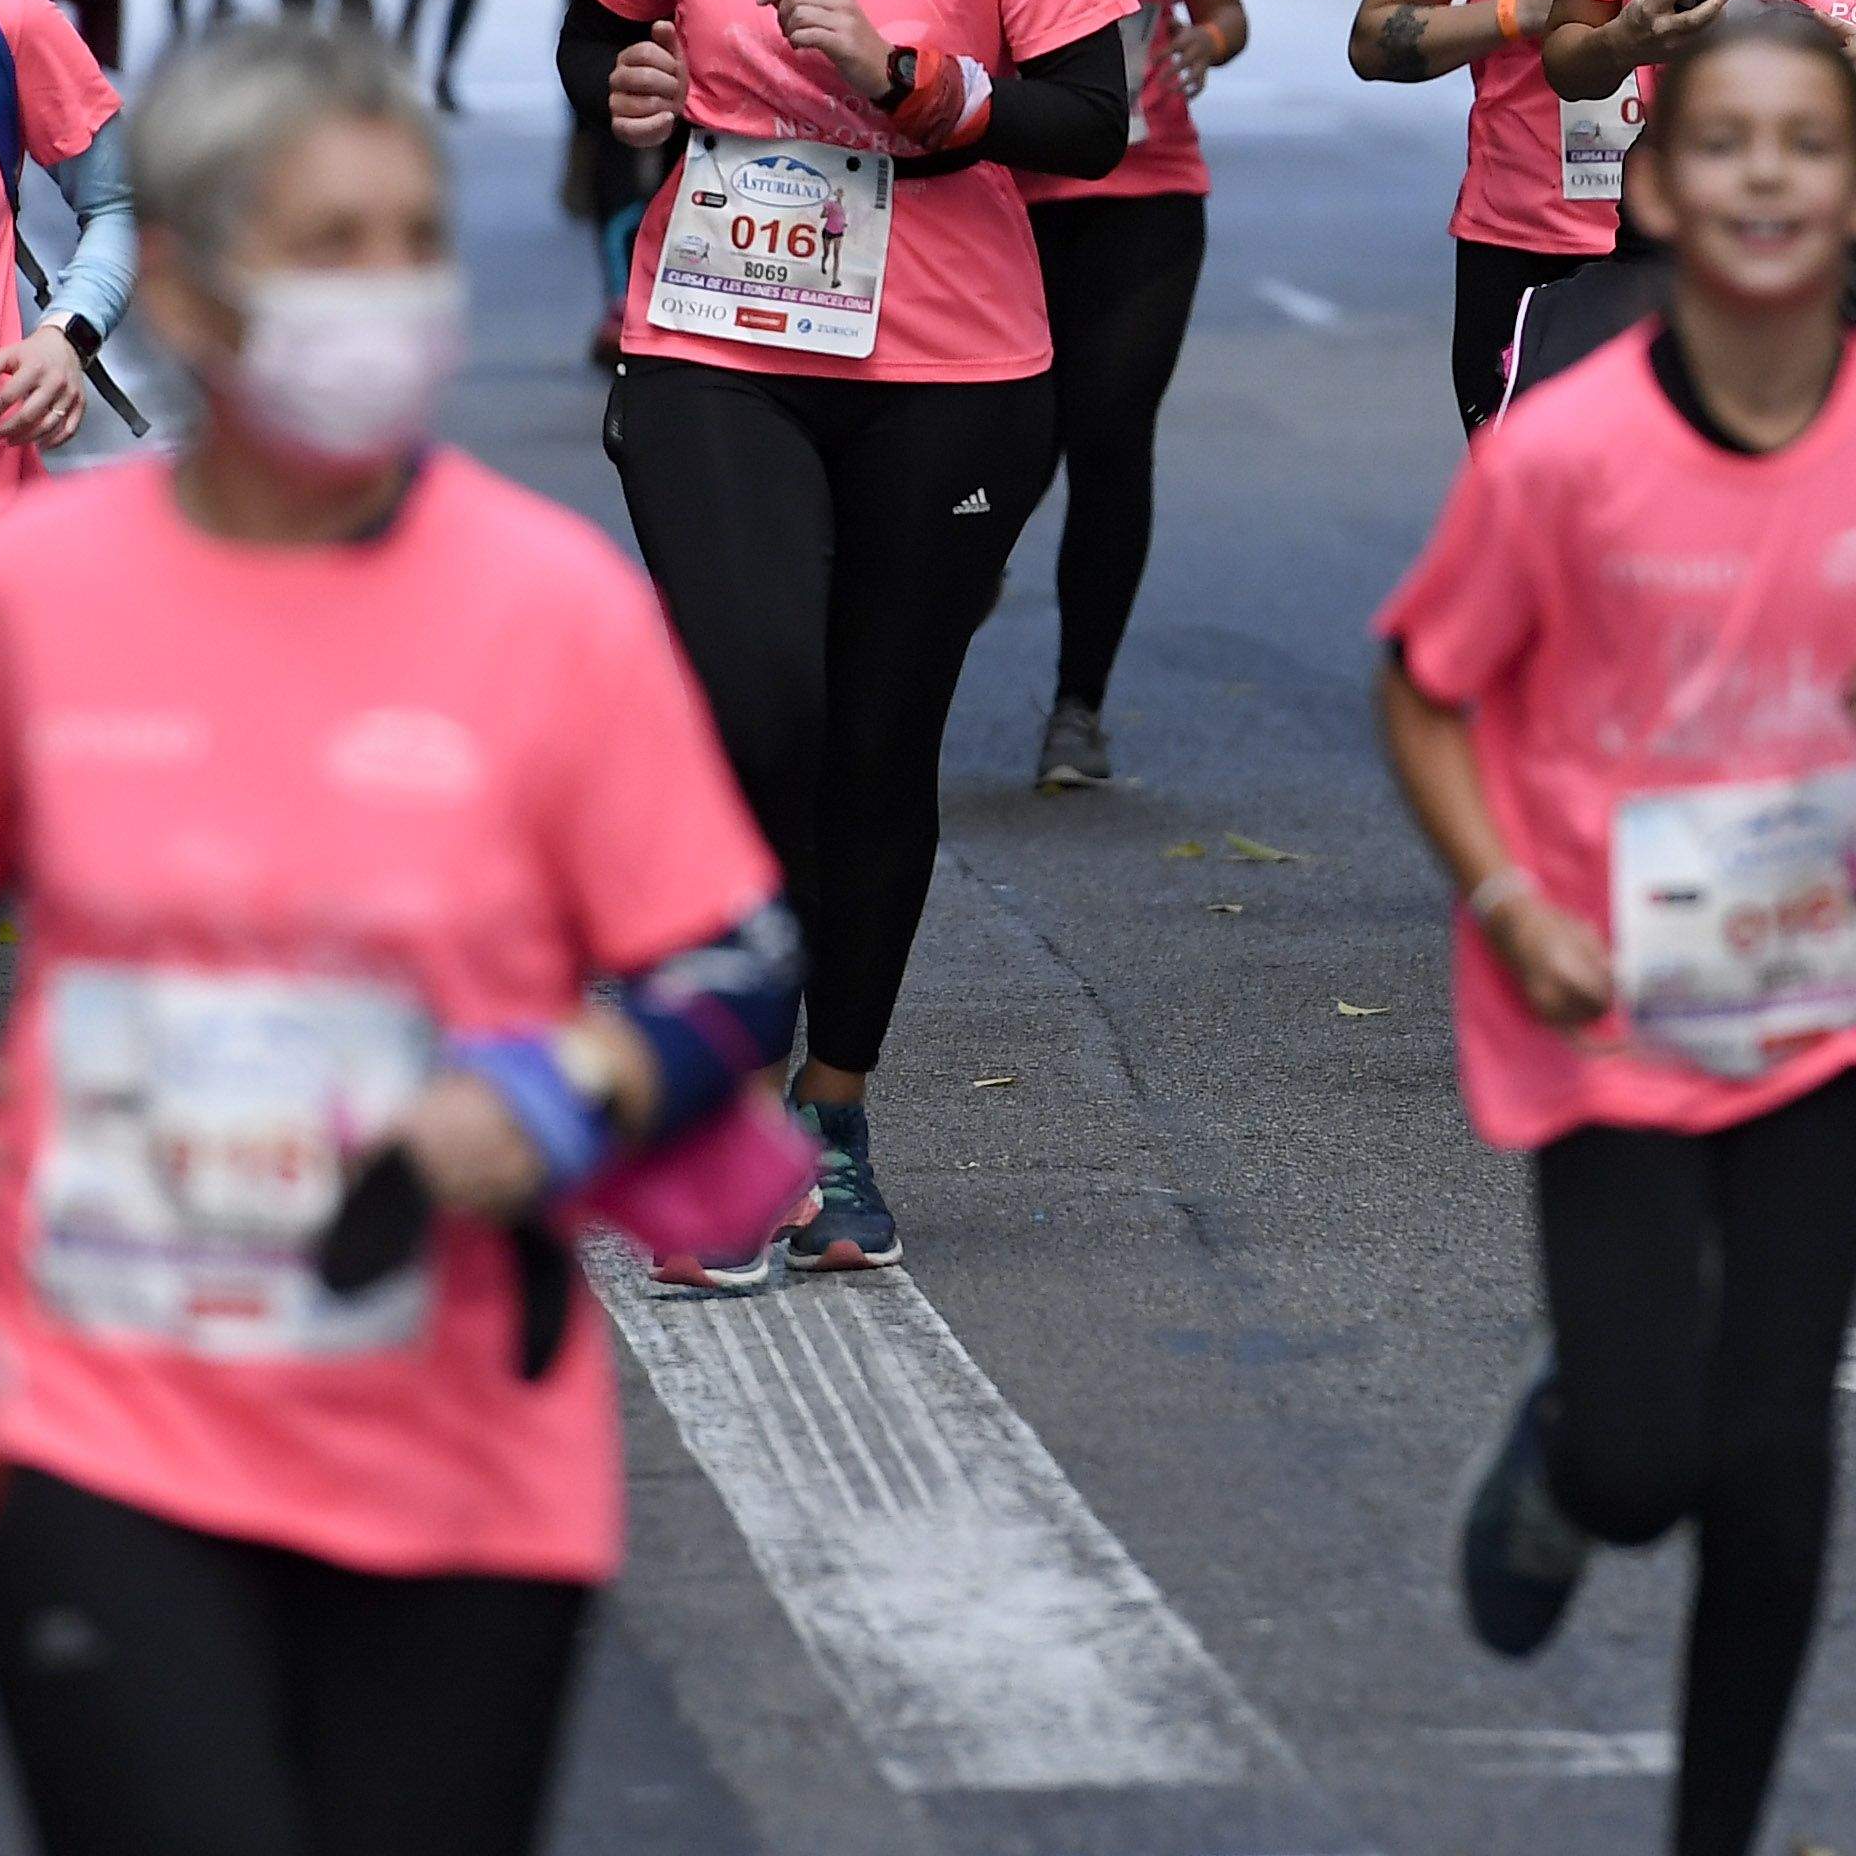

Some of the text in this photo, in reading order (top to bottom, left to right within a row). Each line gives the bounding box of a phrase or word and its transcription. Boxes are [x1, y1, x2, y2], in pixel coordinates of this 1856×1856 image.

[736, 171, 824, 200] ASTURIANA
[731, 215, 817, 258] 016
[744, 260, 788, 283] 8069
[661, 297, 727, 321] OYSHO
[723, 278, 742, 292] LES
[799, 289, 871, 311] BARCELONA
